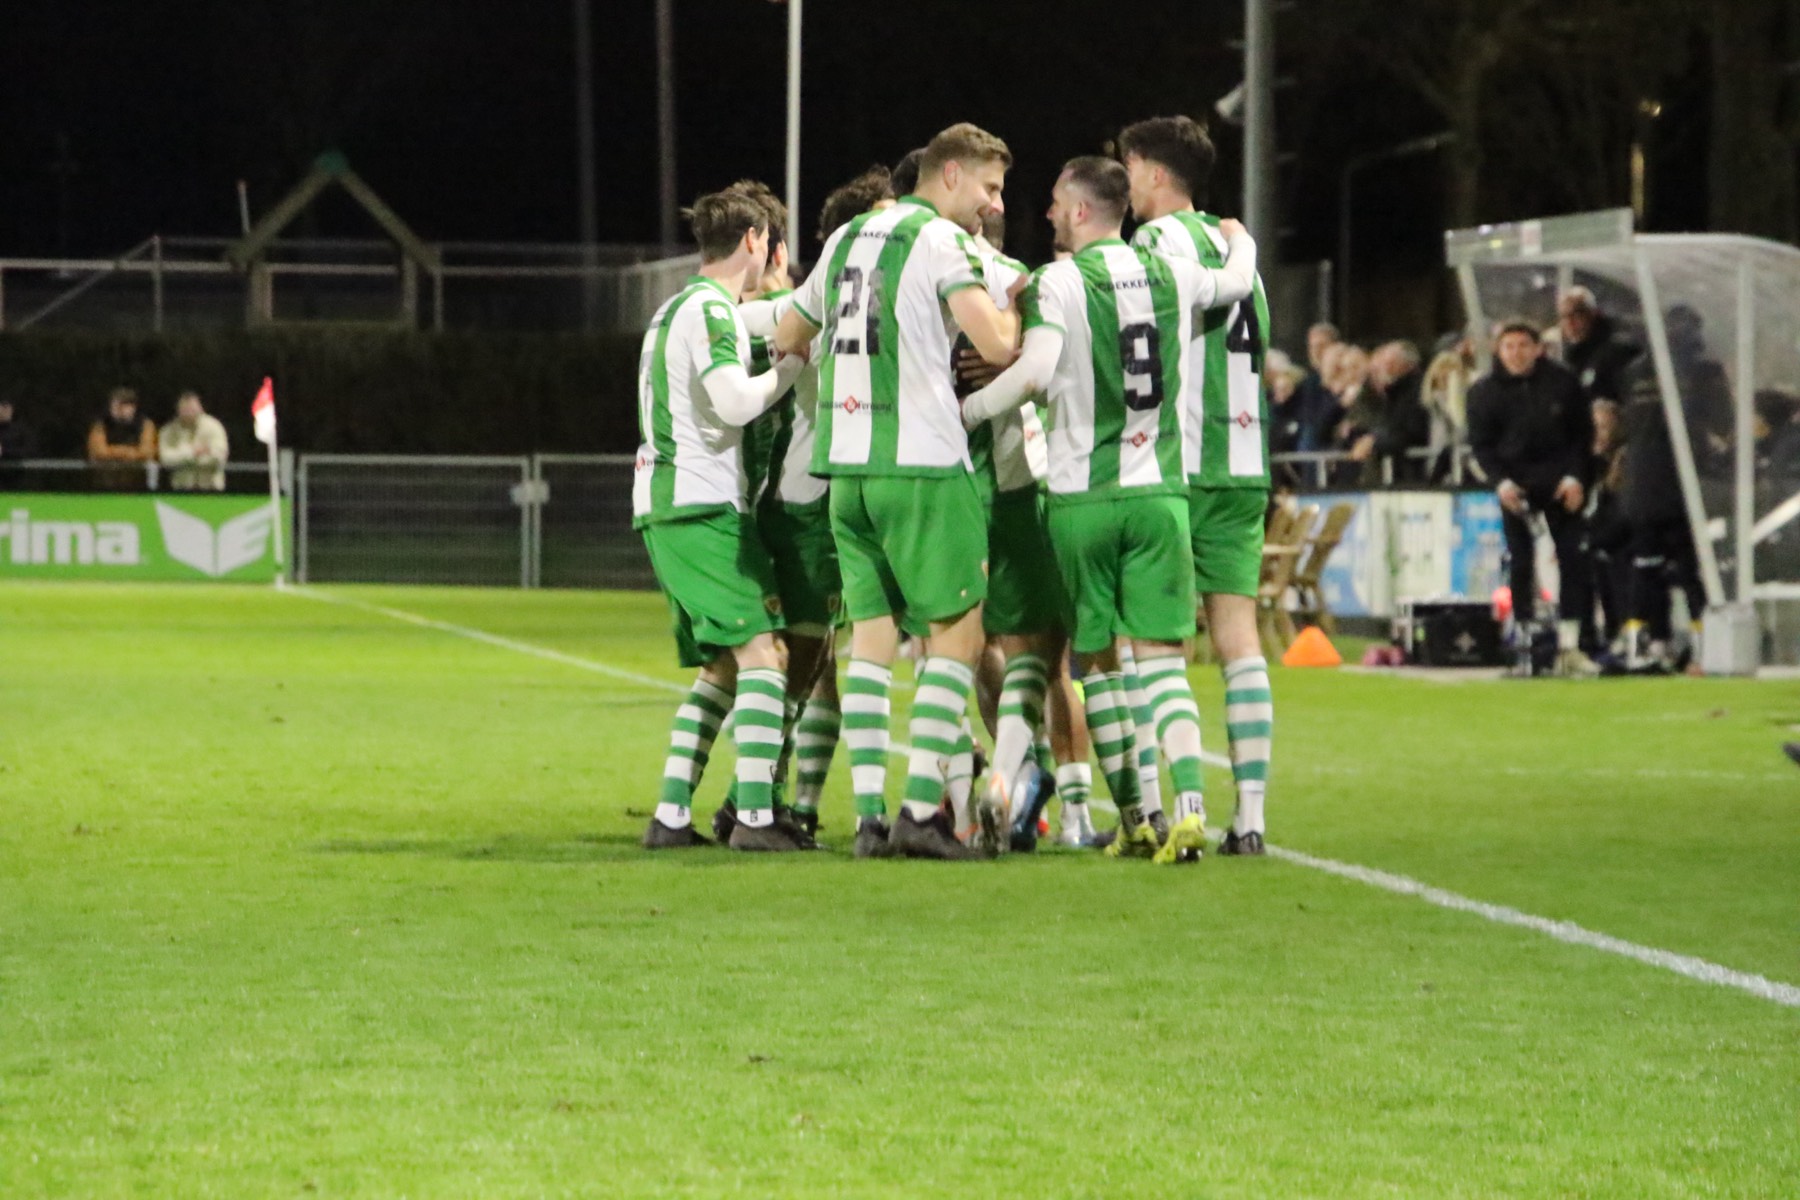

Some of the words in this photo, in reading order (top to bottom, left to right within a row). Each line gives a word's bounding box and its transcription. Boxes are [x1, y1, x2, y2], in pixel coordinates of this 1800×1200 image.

[829, 266, 884, 355] 21
[1226, 292, 1263, 373] 4
[1119, 322, 1164, 411] 9
